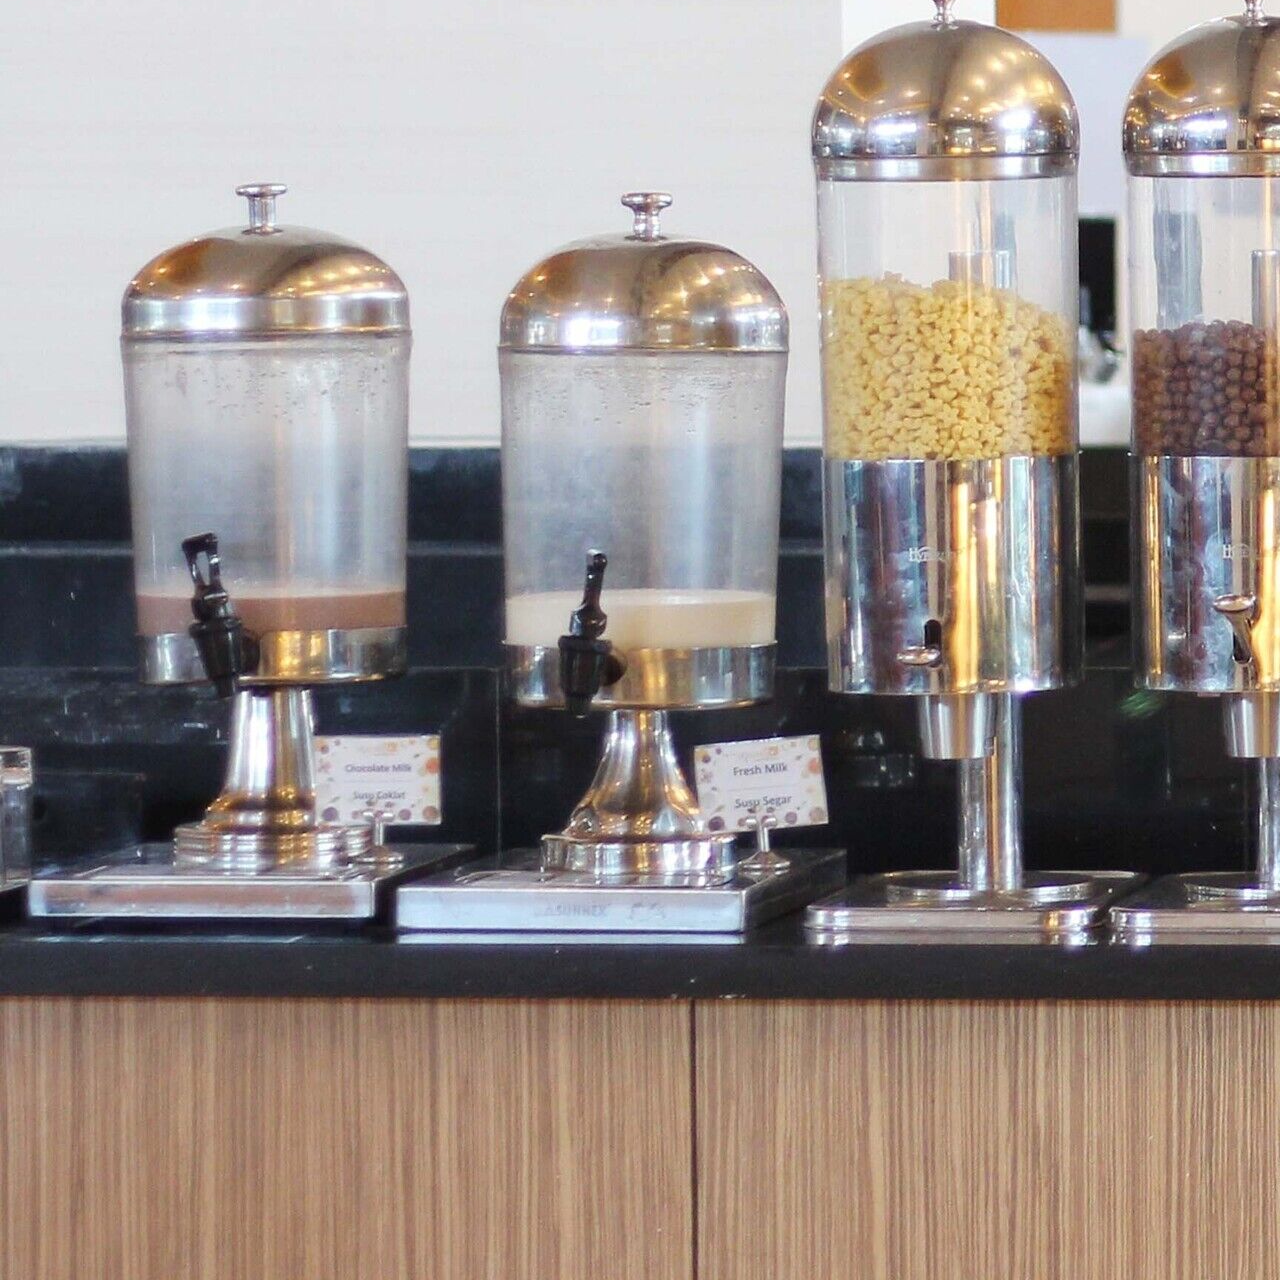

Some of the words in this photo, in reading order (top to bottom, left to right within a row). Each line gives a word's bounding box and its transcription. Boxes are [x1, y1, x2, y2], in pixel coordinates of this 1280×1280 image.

[344, 763, 390, 773] Chocolate
[392, 763, 412, 773] Milk
[733, 764, 762, 776] Fresh
[765, 762, 788, 774] Milk
[376, 790, 406, 800] Coklat
[734, 798, 760, 809] Susu
[762, 795, 792, 808] Segar
